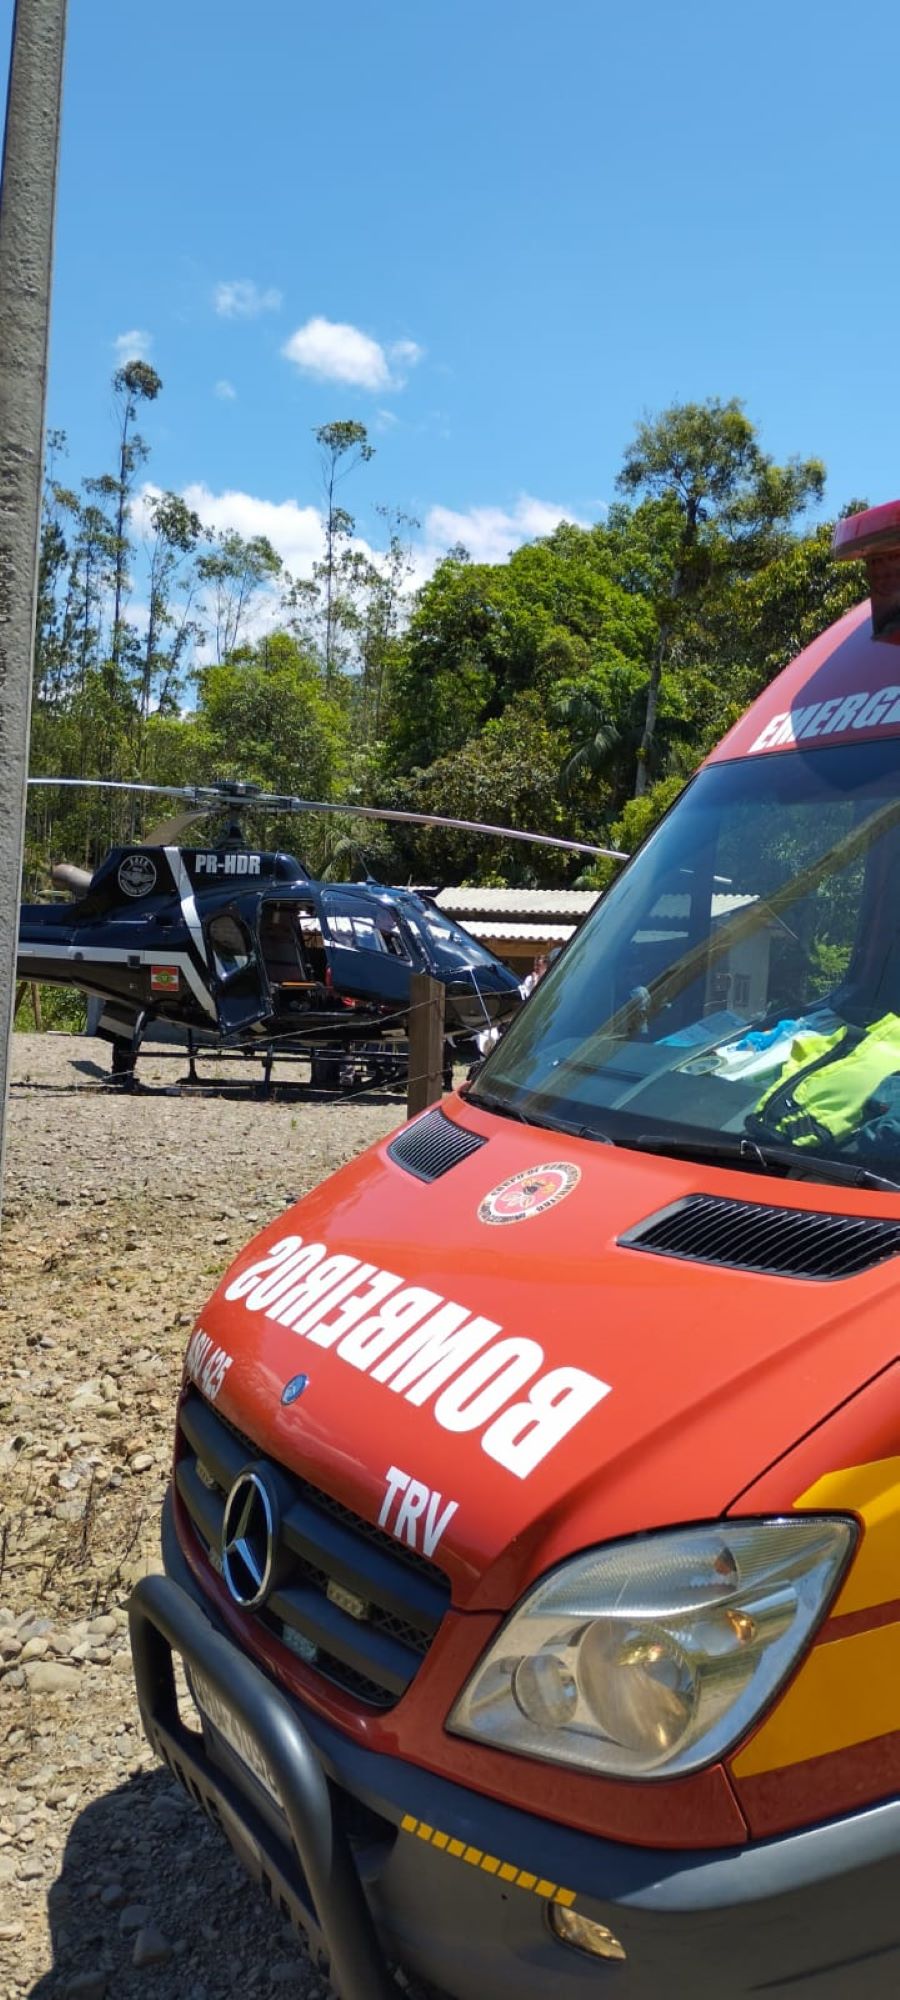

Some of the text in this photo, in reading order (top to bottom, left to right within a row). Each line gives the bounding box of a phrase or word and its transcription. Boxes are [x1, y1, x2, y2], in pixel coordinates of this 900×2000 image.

[195, 854, 261, 874] PR-HDR
[202, 1346, 234, 1401] 425
[378, 1465, 460, 1558] TRV
